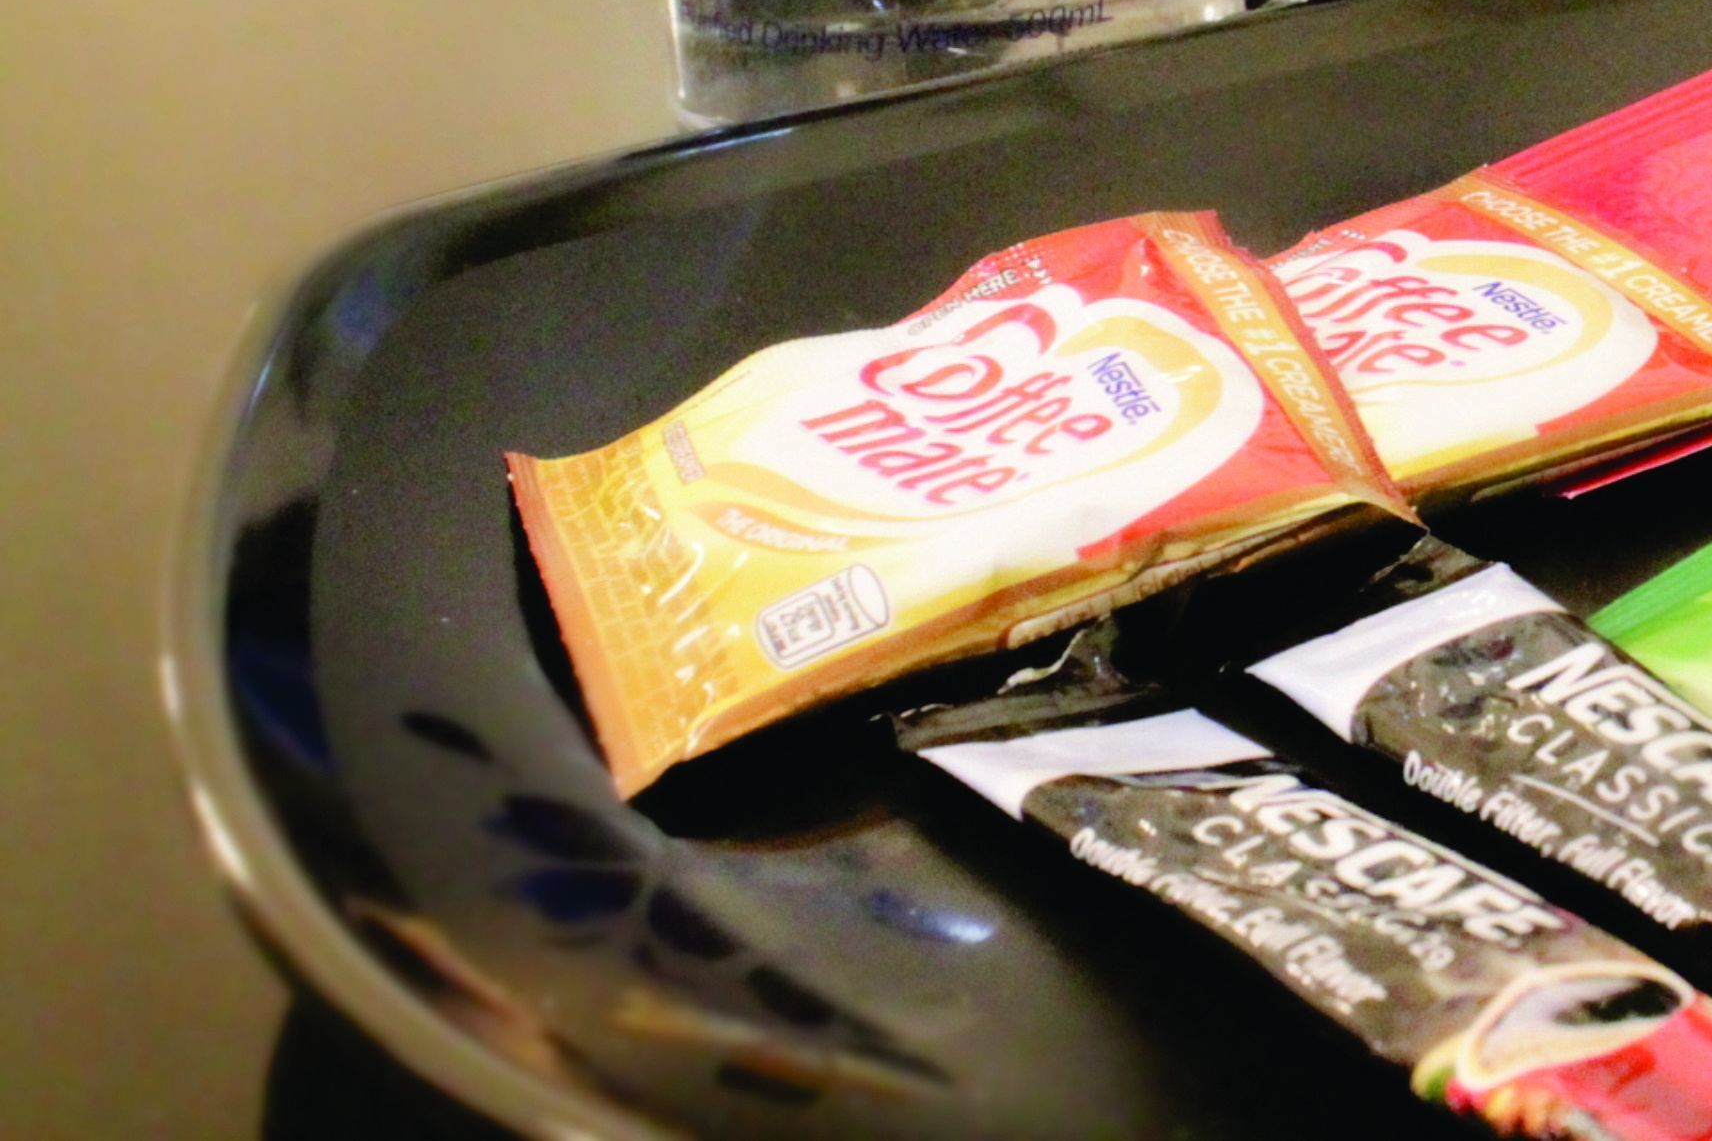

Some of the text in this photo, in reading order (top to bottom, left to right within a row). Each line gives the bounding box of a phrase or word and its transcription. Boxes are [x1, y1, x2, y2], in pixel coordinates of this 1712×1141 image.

[1545, 225, 1601, 255] THE
[1587, 250, 1645, 280] #1
[1214, 283, 1266, 324] THE
[860, 303, 1113, 456] Coffee
[800, 399, 1020, 505] mate
